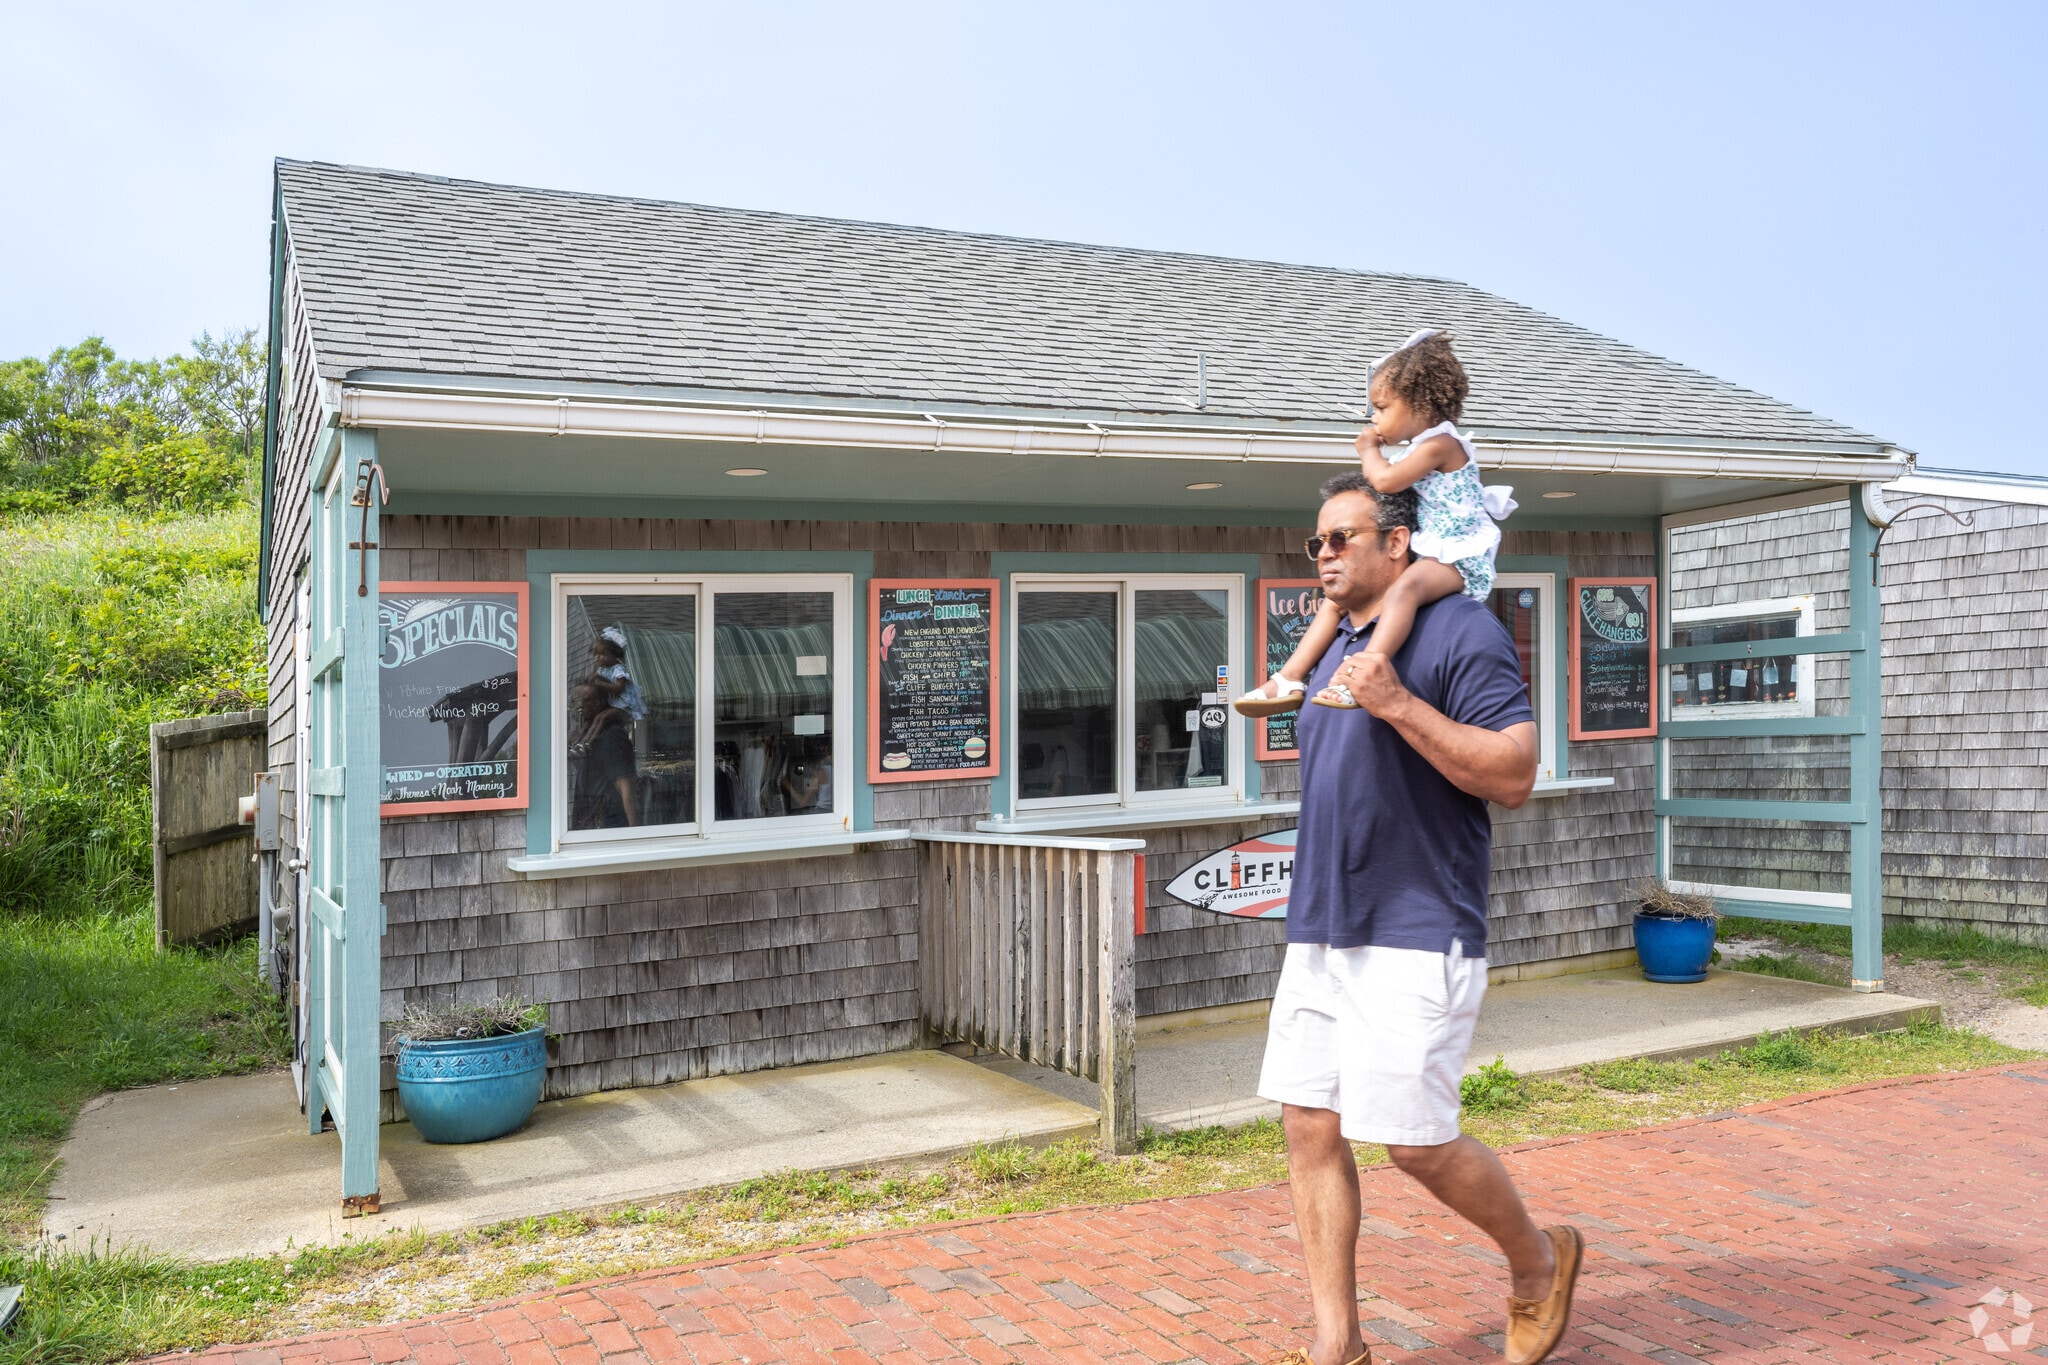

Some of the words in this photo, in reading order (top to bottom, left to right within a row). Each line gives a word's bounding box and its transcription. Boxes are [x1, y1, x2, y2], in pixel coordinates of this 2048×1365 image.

[896, 589, 930, 604] LUNCH
[1269, 591, 1296, 616] Ice
[934, 603, 980, 620] DINNER
[1581, 590, 1643, 641] CLIFFHANGERS
[1625, 612, 1644, 628] GO!
[920, 627, 941, 635] ENGLAND
[956, 626, 977, 634] CHOWDER
[909, 639, 934, 647] LOBSTER
[936, 639, 951, 647] ROLL
[1267, 643, 1282, 654] CUP
[928, 650, 960, 658] SANDWICH
[907, 662, 931, 670] CHICKEN
[933, 660, 959, 669] FINGERS
[436, 685, 462, 695] Fries
[930, 682, 954, 690] BURGER
[911, 695, 926, 703] FISH
[929, 694, 959, 702] SANDWICH
[909, 707, 924, 715] FISH
[928, 706, 949, 714] TACOS
[891, 720, 909, 729] SWEET
[909, 720, 930, 728] POTATO
[949, 718, 962, 726] BEAN
[963, 717, 983, 725] BURGER
[1205, 712, 1222, 723] AQ
[896, 732, 911, 740] SWEET
[954, 728, 975, 736] NOODLES
[386, 770, 422, 782] WNED
[436, 765, 492, 779] OPERATED
[495, 763, 508, 775] BY
[379, 789, 396, 802] aul,
[396, 787, 430, 801] Theresa
[437, 782, 464, 799] Noah
[466, 779, 513, 799] Manning
[1194, 850, 1293, 890] CLIFFH
[1223, 890, 1258, 900] AWESOME
[1262, 887, 1282, 895] FOOD
